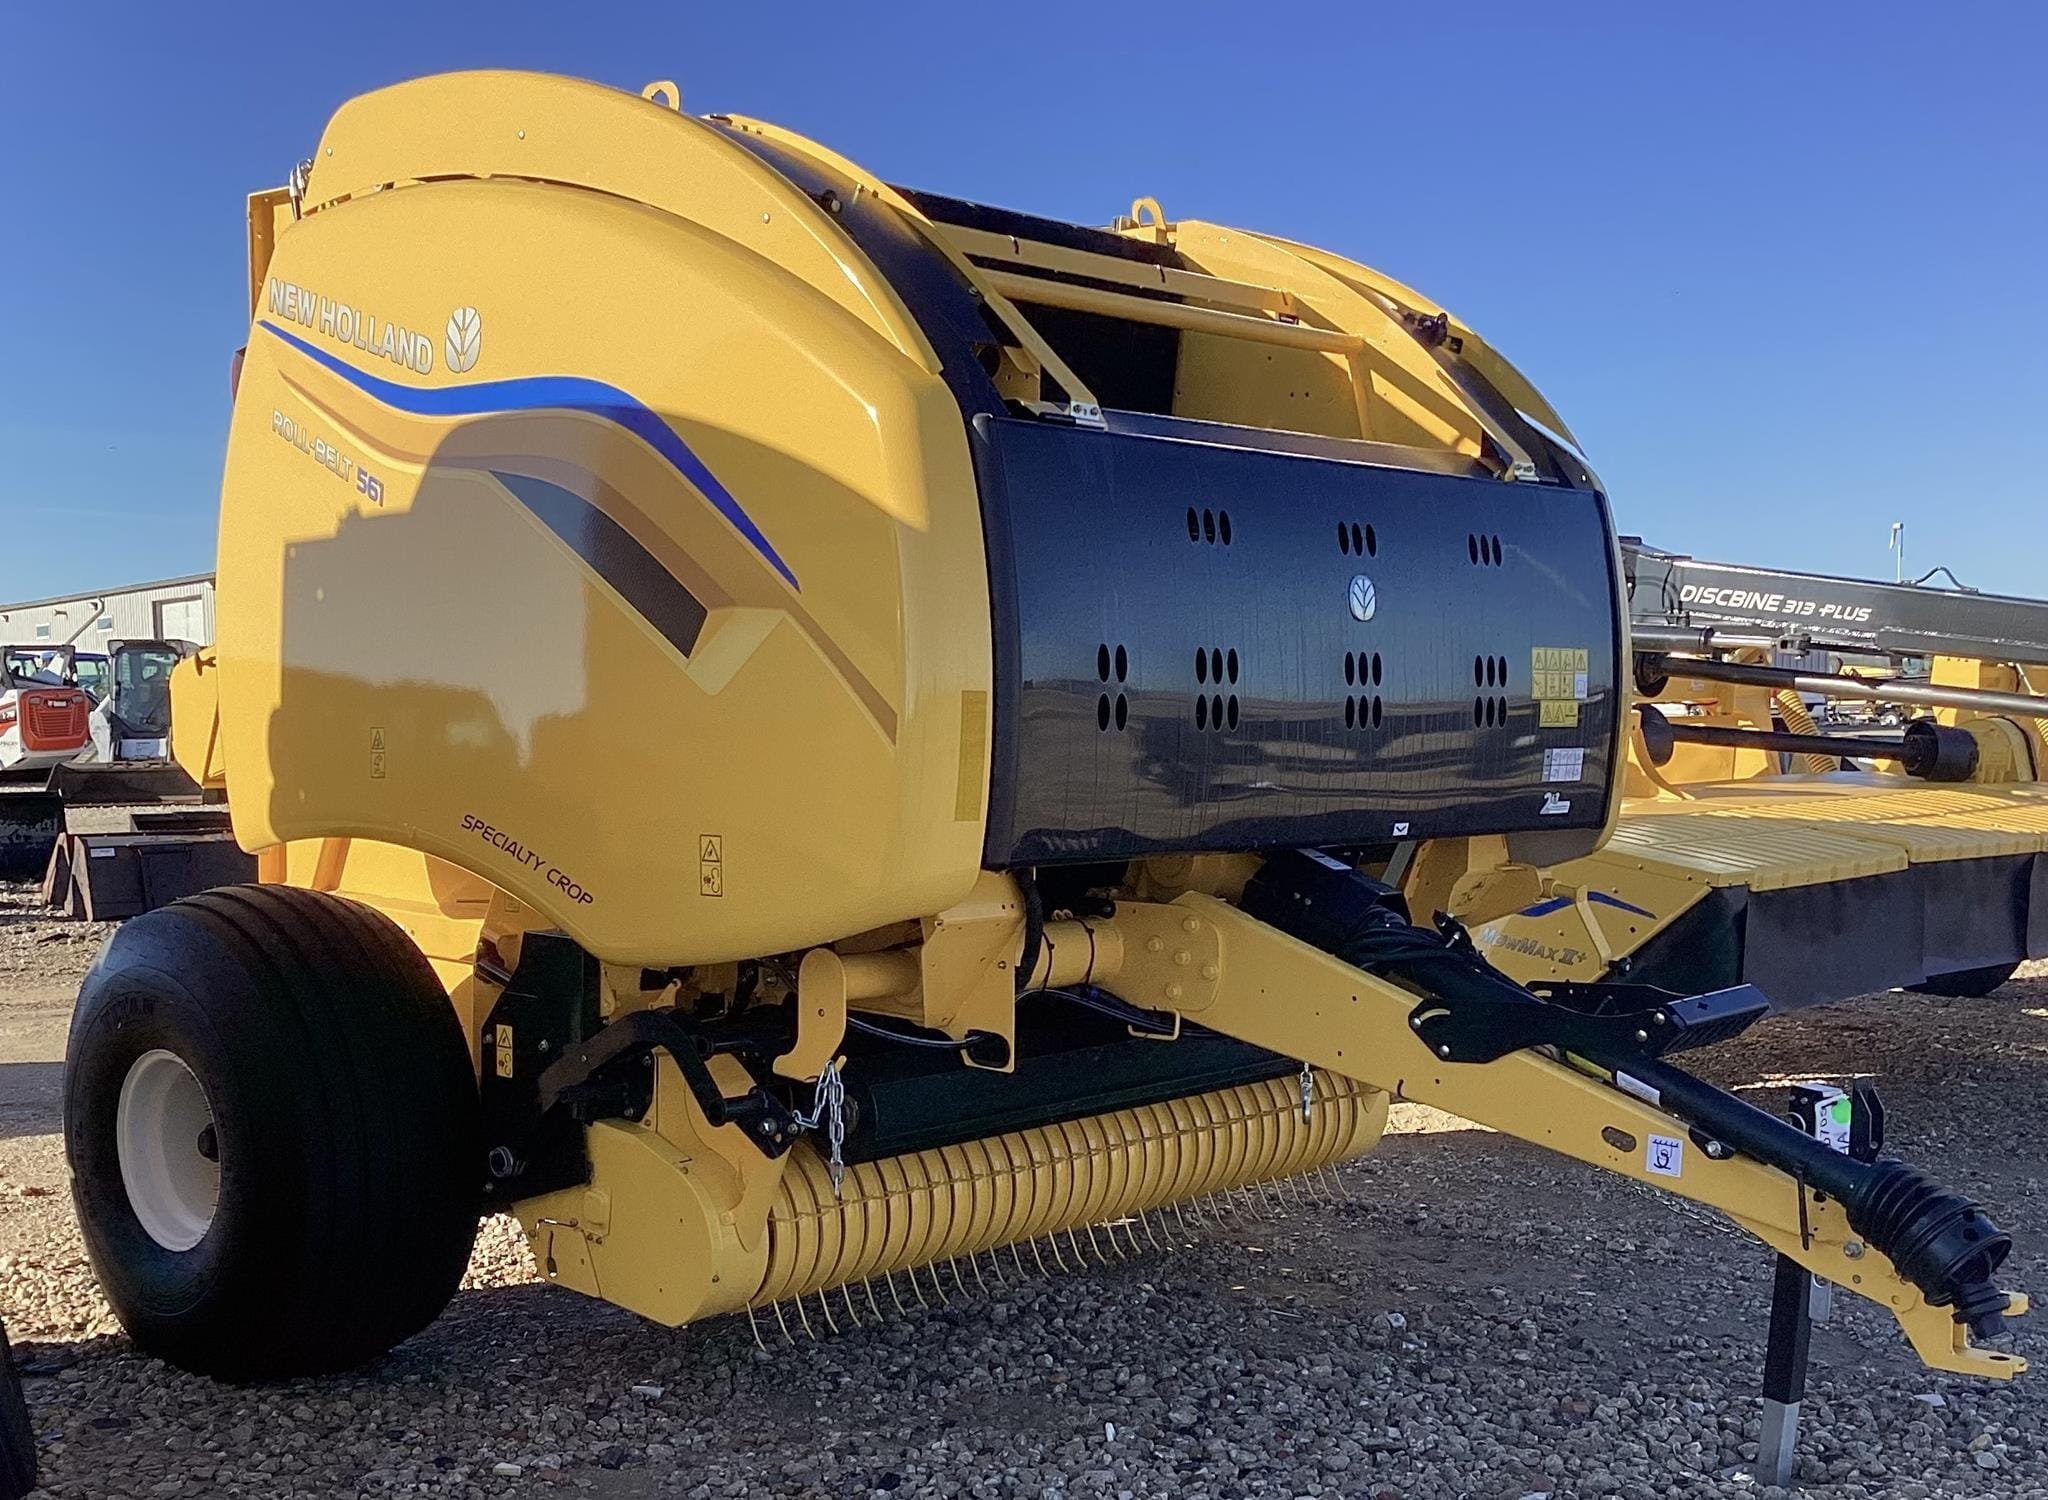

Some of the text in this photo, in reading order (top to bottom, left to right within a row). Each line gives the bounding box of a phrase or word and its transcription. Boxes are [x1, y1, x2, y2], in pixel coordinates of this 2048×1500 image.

[269, 278, 433, 375] NEW HOLLAND
[272, 410, 385, 507] ROLL-BELT 561
[1680, 585, 1784, 611] DISCBINE
[1781, 599, 1816, 616] 313
[461, 814, 594, 904] SPECIALTY CROP
